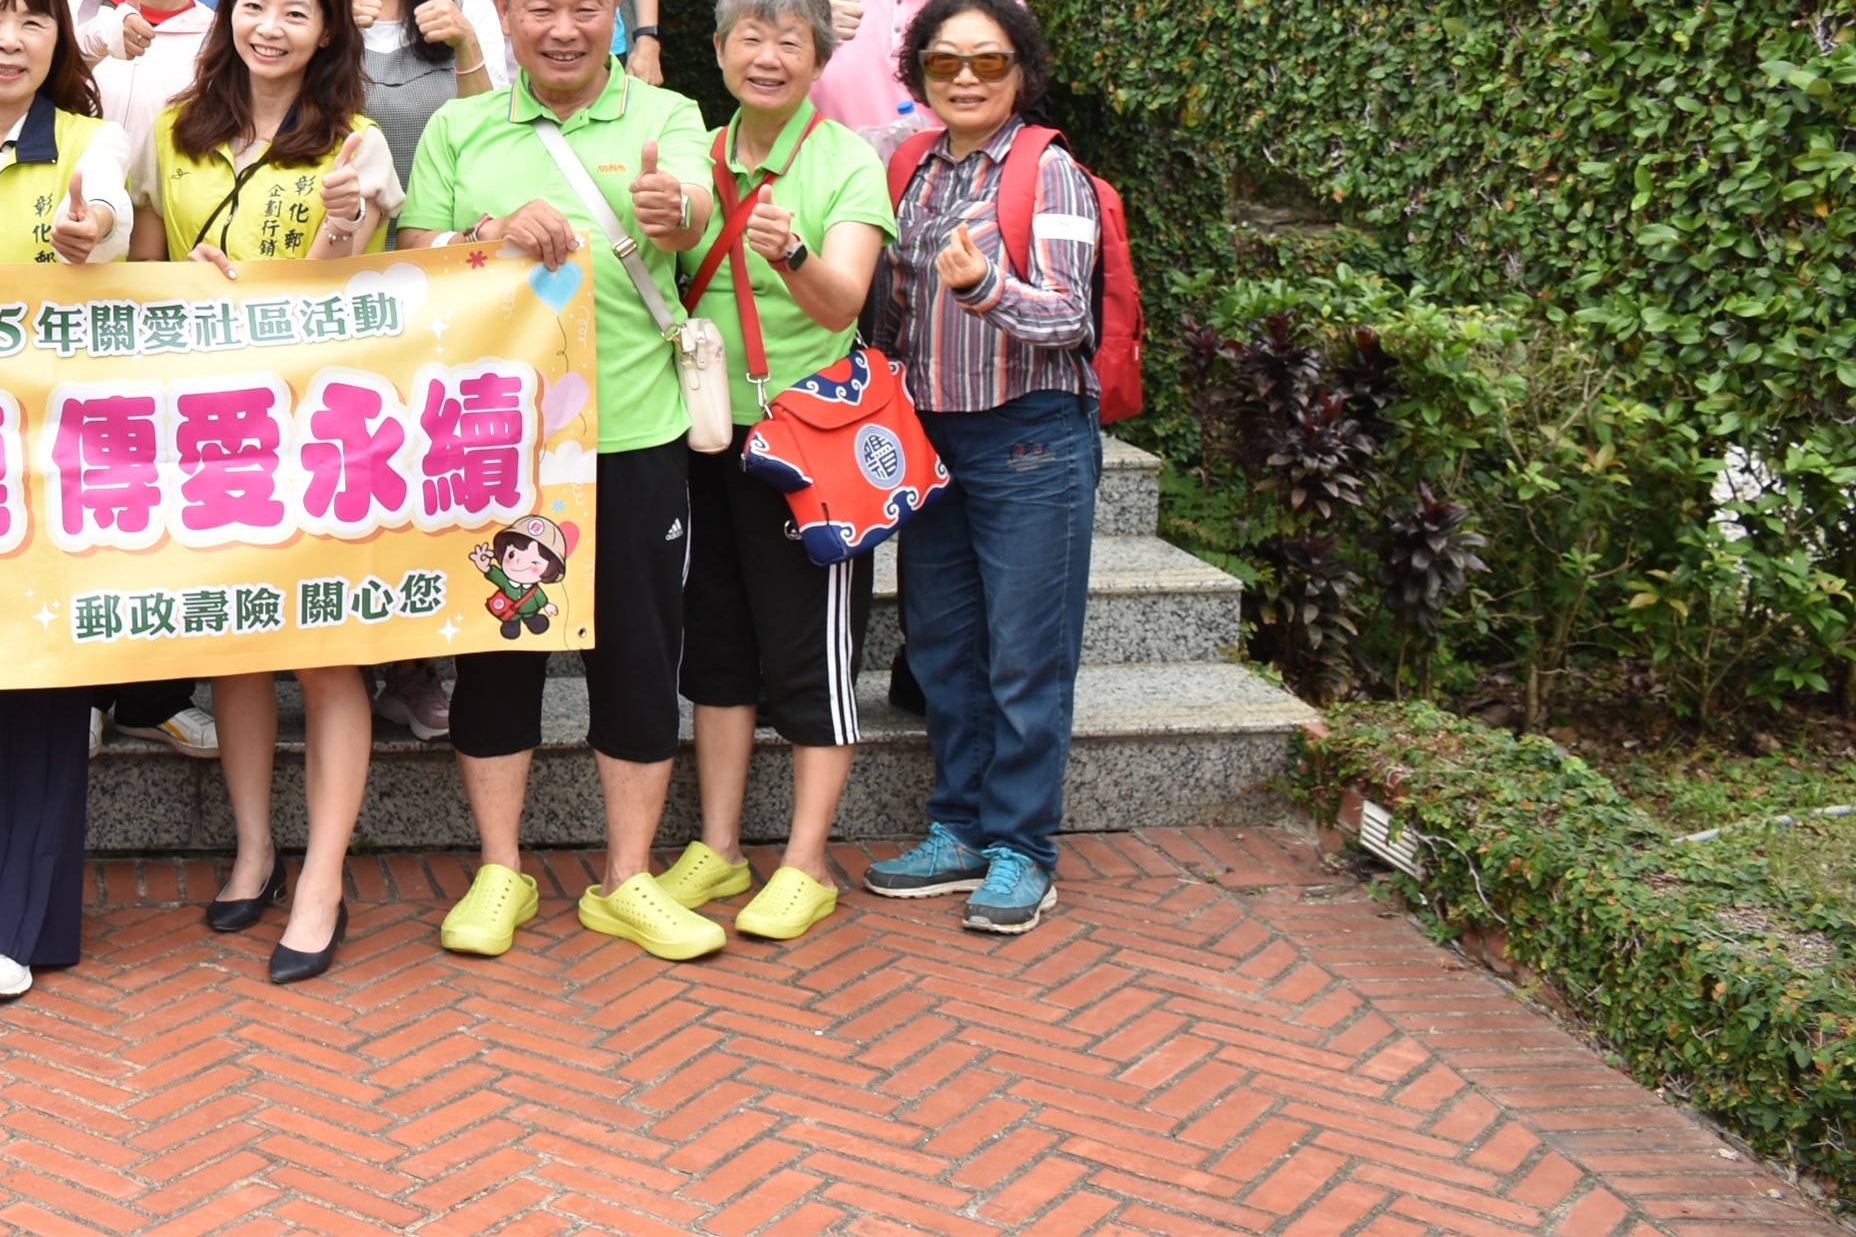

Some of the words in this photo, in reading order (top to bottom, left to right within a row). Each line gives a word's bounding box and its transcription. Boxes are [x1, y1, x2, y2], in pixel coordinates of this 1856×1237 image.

[258, 183, 286, 260] 企劃行銷
[284, 175, 316, 260] 彰化郵
[51, 371, 523, 536] 傳愛永續
[74, 588, 284, 639] 郵政壽險
[300, 572, 447, 624] 關心您
